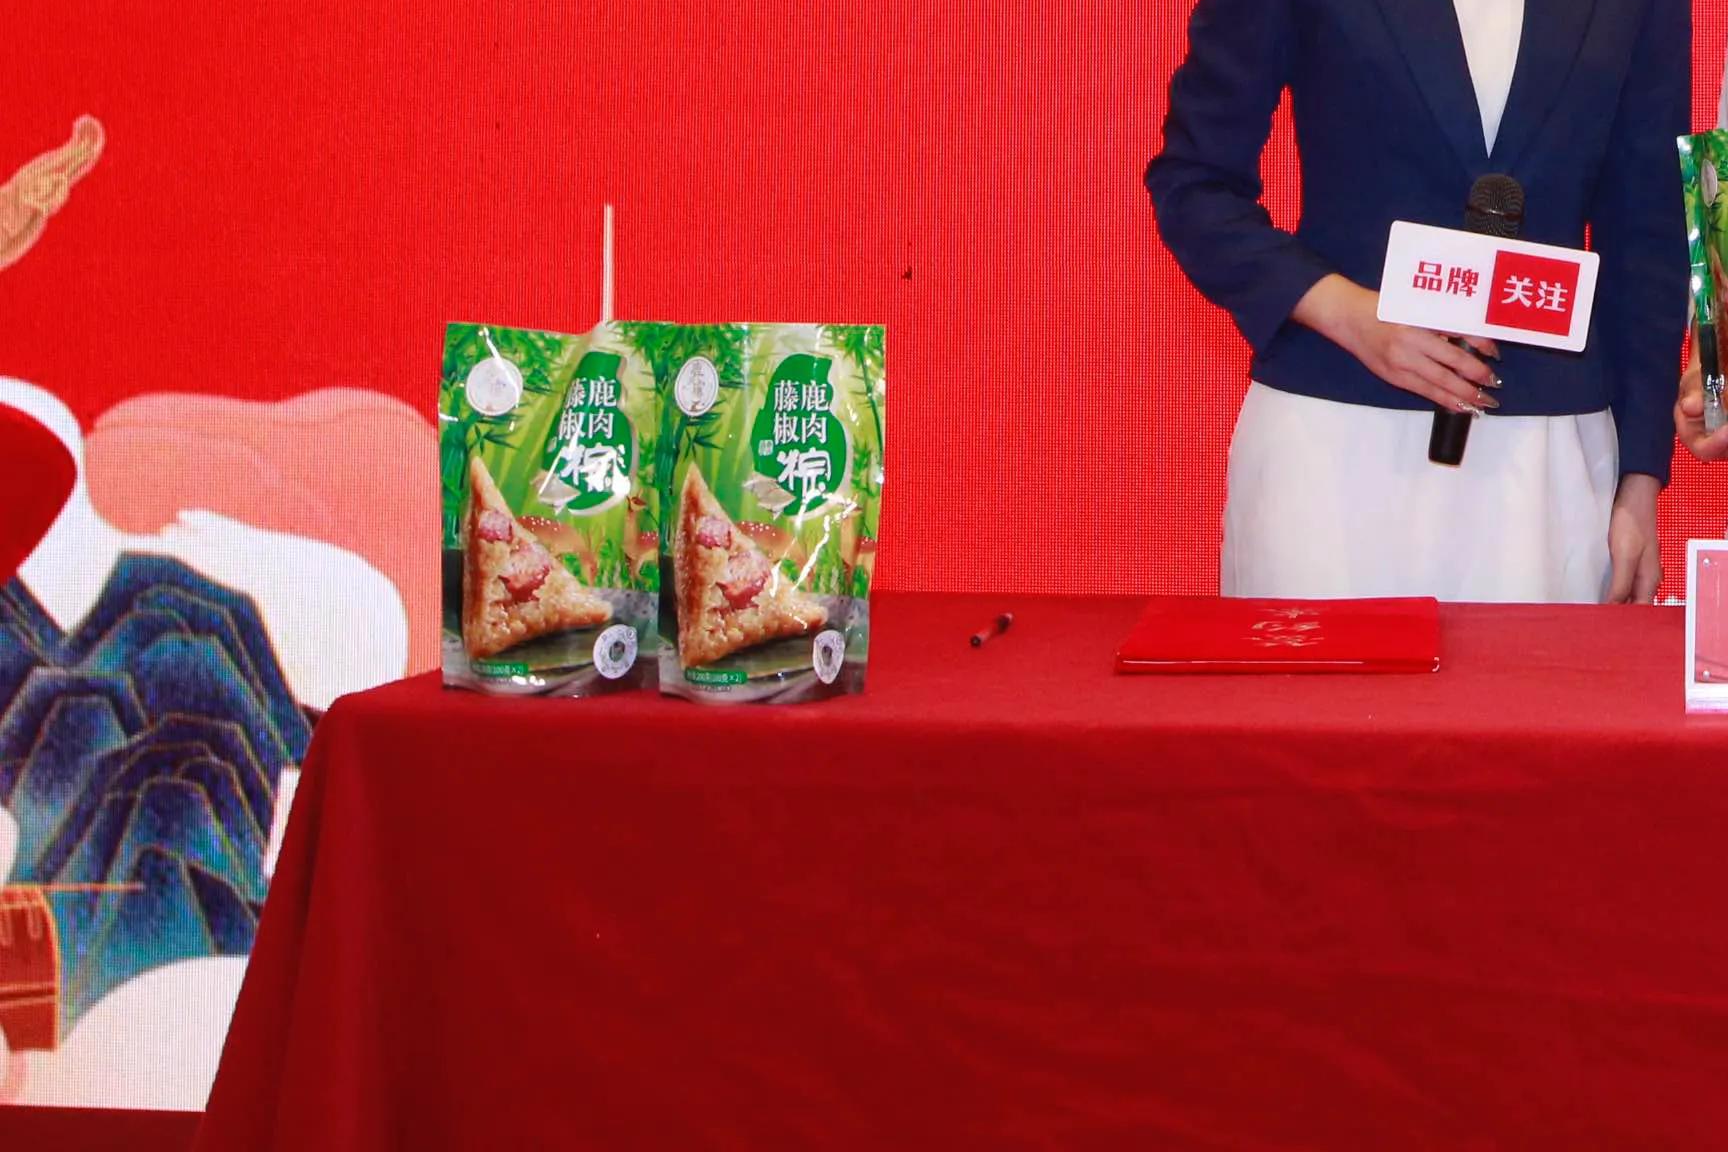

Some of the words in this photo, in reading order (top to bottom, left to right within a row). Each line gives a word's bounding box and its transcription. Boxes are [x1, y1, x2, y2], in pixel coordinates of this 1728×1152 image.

[1411, 260, 1480, 298] 品牌
[1501, 274, 1569, 313] 关注
[587, 375, 617, 440] 鹿肉
[773, 379, 800, 446] 藤椒
[800, 379, 830, 445] 鹿肉
